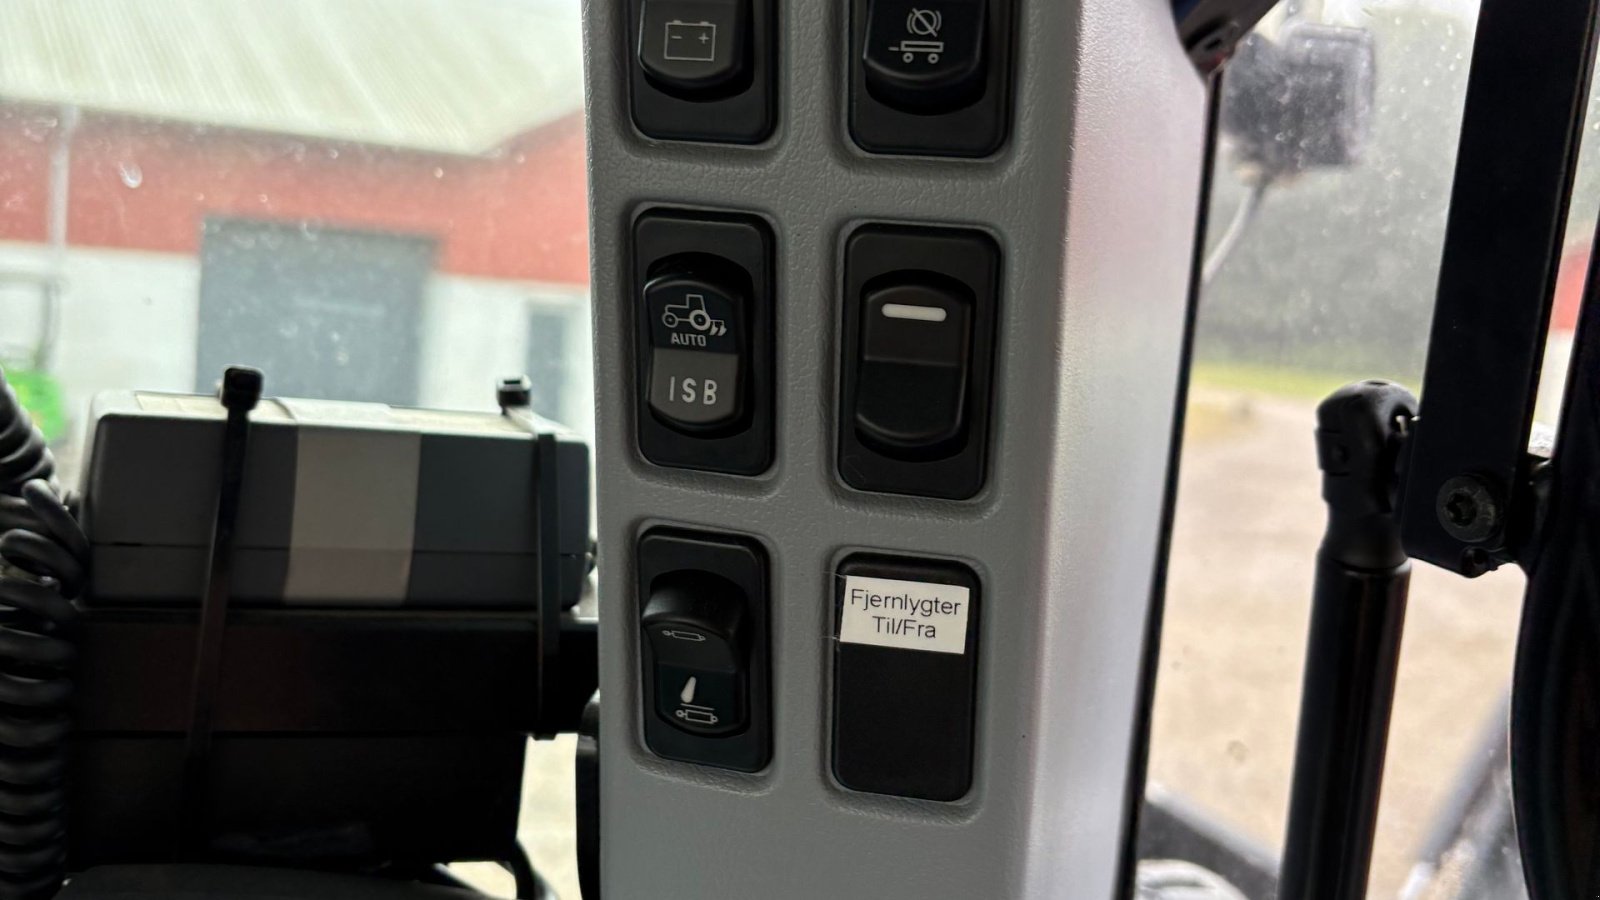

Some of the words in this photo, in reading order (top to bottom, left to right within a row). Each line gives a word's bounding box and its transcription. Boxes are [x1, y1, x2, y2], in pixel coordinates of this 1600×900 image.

[670, 333, 706, 347] AUTO
[669, 376, 718, 405] ISB
[851, 588, 961, 617] Fjernlygter
[872, 615, 936, 638] Til/Fra
